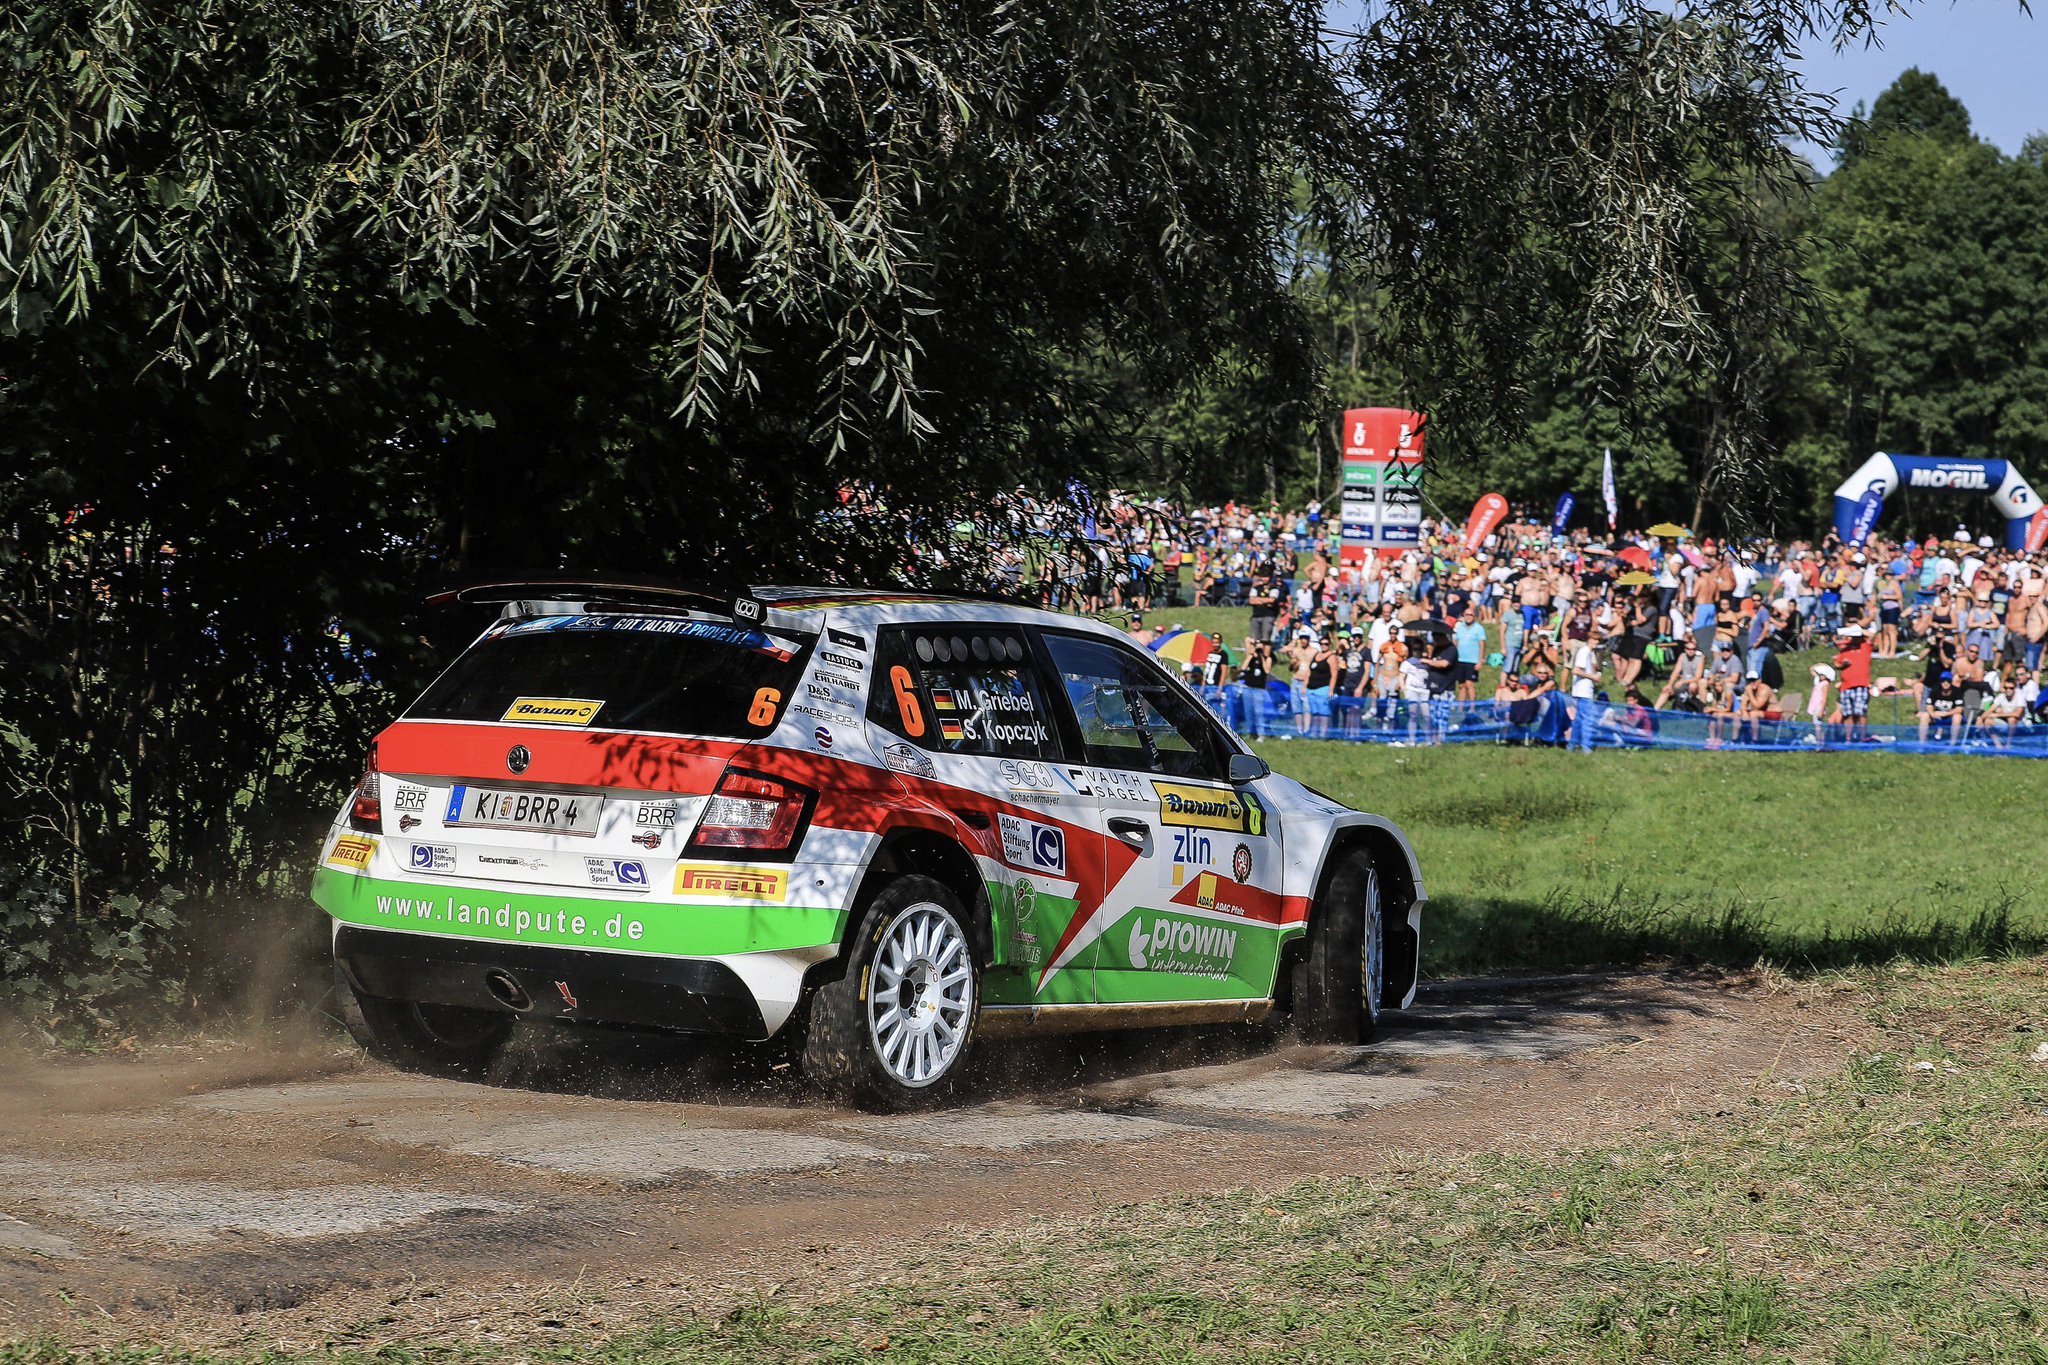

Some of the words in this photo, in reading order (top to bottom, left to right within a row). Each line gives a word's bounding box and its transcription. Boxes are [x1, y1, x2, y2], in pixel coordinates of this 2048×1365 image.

[1910, 468, 1989, 489] MOGUL
[613, 618, 637, 631] GOT
[641, 619, 692, 633] TALENT?
[688, 624, 731, 643] PROVE
[825, 653, 860, 669] BASTUCK
[807, 683, 831, 698] D&S
[814, 672, 861, 692] EHLHARDT
[747, 687, 781, 726] 6
[890, 665, 925, 737] 6
[955, 689, 977, 710] M.
[978, 690, 1035, 712] Griebel
[518, 704, 578, 716] Barum
[963, 718, 982, 741] S.
[982, 719, 1050, 746] Kopczyk
[999, 759, 1054, 788] SCH
[1086, 770, 1142, 787] VAUTH
[395, 791, 427, 808] BRR
[1010, 793, 1060, 806] schachermayer
[1096, 786, 1150, 802] SAGEL
[450, 808, 457, 817] A
[474, 792, 499, 820] KI
[514, 795, 560, 825] BRR
[565, 799, 578, 826] 4
[1163, 793, 1229, 818] Barum
[1243, 793, 1261, 835] 6
[636, 807, 676, 826] BRR
[1001, 817, 1021, 832] ADAC
[1003, 832, 1031, 851] Stiftung
[331, 840, 372, 863] PIRELLI
[434, 847, 449, 855] ADAC
[434, 854, 455, 864] Stiftung
[1005, 846, 1023, 861] Sport
[588, 858, 605, 867] ADAC
[589, 867, 615, 876] Stiftung
[591, 875, 609, 884] Sport
[682, 869, 779, 895] PIRELLI
[1197, 896, 1214, 908] ADAC
[1215, 902, 1231, 913] ADAC
[1231, 903, 1245, 915] Pfalz
[376, 895, 645, 940] www.landpute.de
[1151, 950, 1231, 981] international
